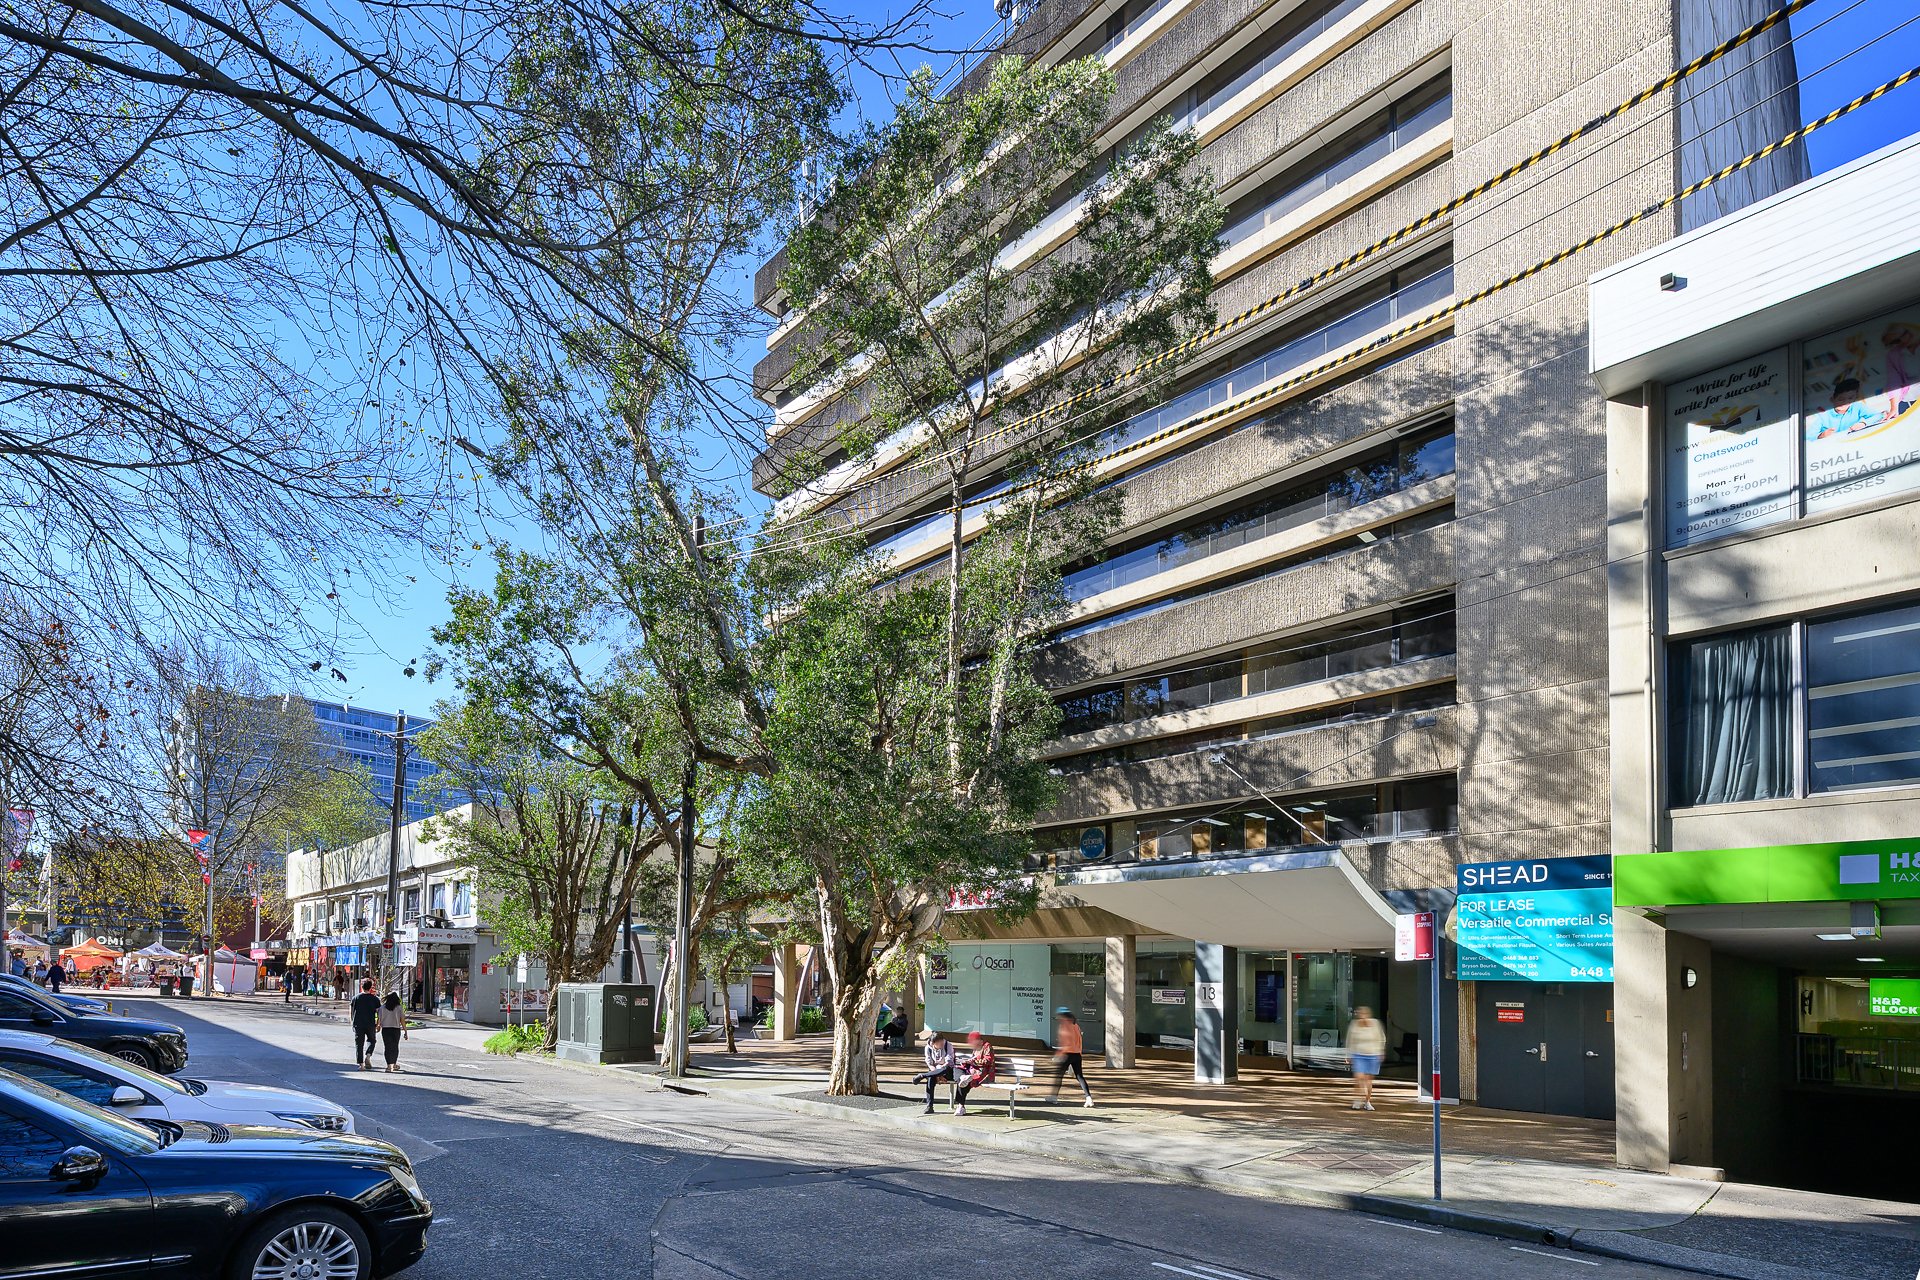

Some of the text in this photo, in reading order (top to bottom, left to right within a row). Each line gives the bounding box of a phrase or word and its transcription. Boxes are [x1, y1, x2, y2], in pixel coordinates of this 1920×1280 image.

[1726, 372, 1746, 388] for
[1748, 364, 1767, 378] life
[1674, 401, 1702, 416] write
[1703, 394, 1722, 409] for
[1694, 437, 1758, 463] Chatswood
[1698, 458, 1755, 478] OPENING HOURS
[1810, 451, 1864, 472] SMALL
[1810, 450, 1920, 487] INTERACTIVE
[1706, 480, 1726, 489] Mon
[1734, 473, 1746, 482] Fri
[1811, 475, 1886, 502] CLASSES
[1676, 492, 1718, 509] 3:30PM
[1734, 475, 1778, 493] 7:00PM
[1704, 508, 1720, 517] Sat
[1730, 501, 1749, 511] Sun
[1676, 520, 1718, 535] 9:00AM
[1734, 503, 1779, 521] 7:00PM
[1463, 864, 1548, 887] SHEAD
[1584, 873, 1605, 881] SINCE
[1890, 872, 1920, 883] TAX
[1460, 899, 1535, 913] FOR LEASE
[1460, 917, 1512, 929] Versatile
[1515, 914, 1594, 927] Commercial
[985, 957, 1015, 970] Qscan
[1570, 967, 1603, 977] 8448
[1202, 987, 1216, 1000] 13
[1872, 997, 1901, 1006] H&R
[1872, 1005, 1919, 1015] BLOCK
